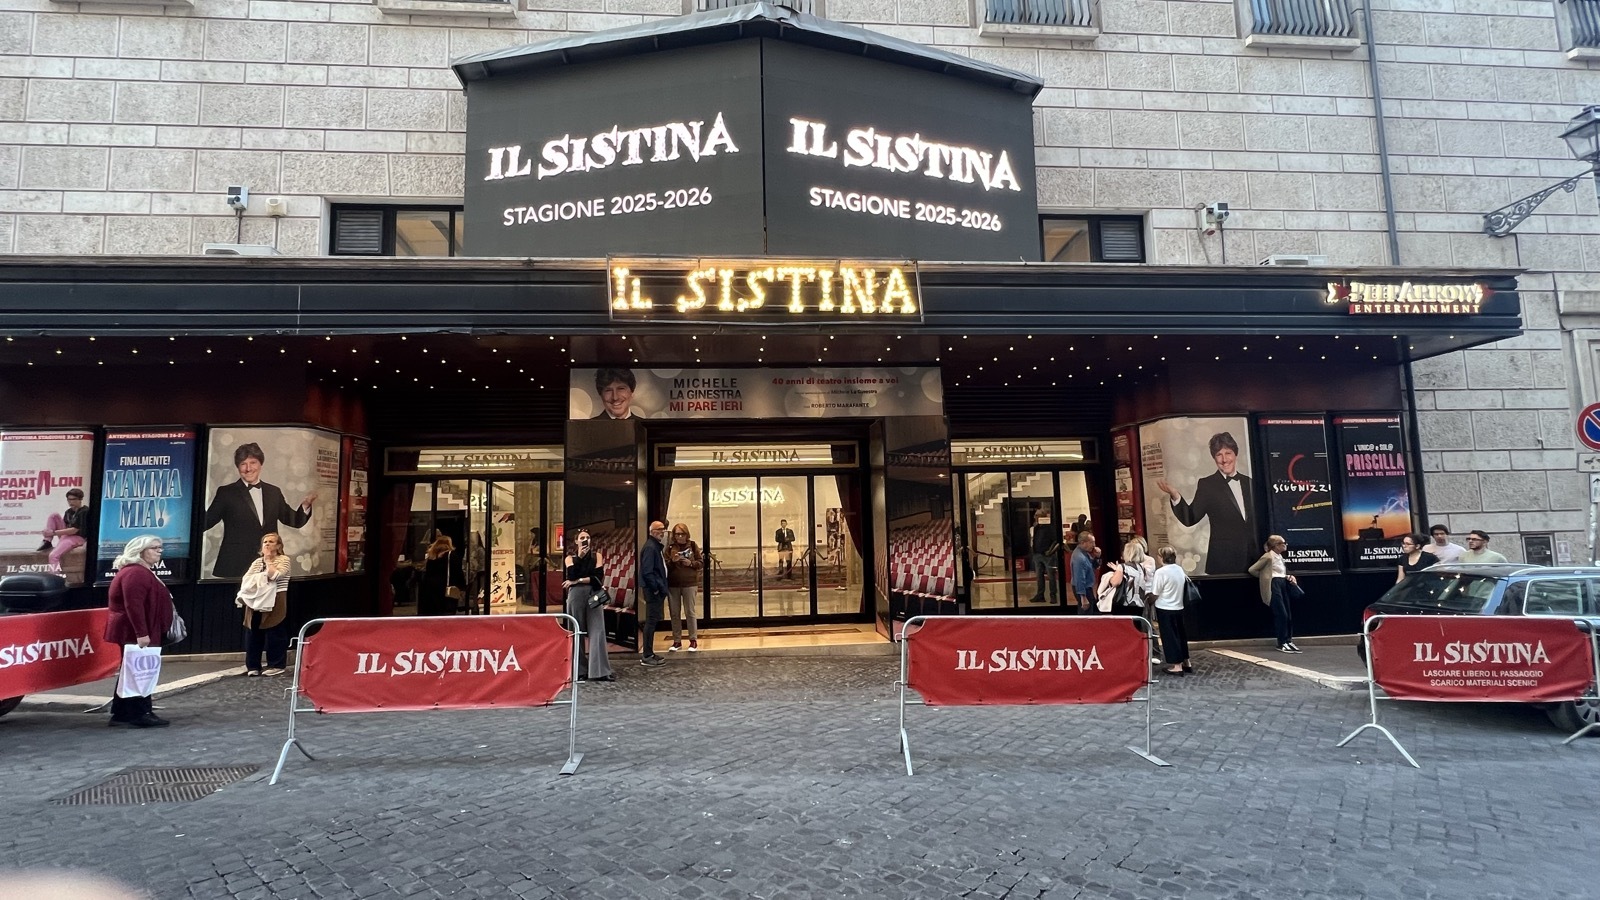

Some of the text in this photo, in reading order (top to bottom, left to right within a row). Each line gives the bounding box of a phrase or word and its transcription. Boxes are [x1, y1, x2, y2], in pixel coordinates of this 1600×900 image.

[484, 112, 740, 181] IL SISTINA
[787, 118, 1022, 192] IL SISTINA
[502, 187, 713, 226] STAGIONE 2025-2026
[809, 187, 1002, 232] STAGIONE 2025-2026
[676, 267, 917, 313] SISTINA
[1355, 304, 1480, 314] ENTERTAINMENT
[673, 378, 738, 388] MICHELE
[806, 377, 815, 385] di
[670, 389, 742, 400] LA GINESTRA
[669, 401, 743, 411] MI PARE IERI
[120, 455, 171, 466] FINALMENTE!
[712, 449, 800, 463] IL SISTINA
[1345, 453, 1405, 471] PRISCILLA
[0, 470, 83, 496] PANTALONI
[104, 469, 182, 499] MAMMA
[1273, 483, 1332, 493] SCUGNIZZI
[0, 489, 37, 500] ROSA
[120, 499, 167, 529] MIA!
[1296, 549, 1328, 558] SISTINA
[1373, 546, 1405, 555] SISTINA
[6, 562, 63, 573] IL SISTINA
[0, 634, 95, 669] SISTINA
[1413, 639, 1552, 667] IL SISTINA
[353, 645, 522, 676] IL SISTINA
[954, 645, 1105, 674] IL SISTINA
[1462, 670, 1491, 678] LIBERO
[1491, 670, 1499, 678] IL
[1500, 670, 1544, 678] PASSAGGIO
[1430, 679, 1538, 687] SCARICO MATERIALI SCENICI
